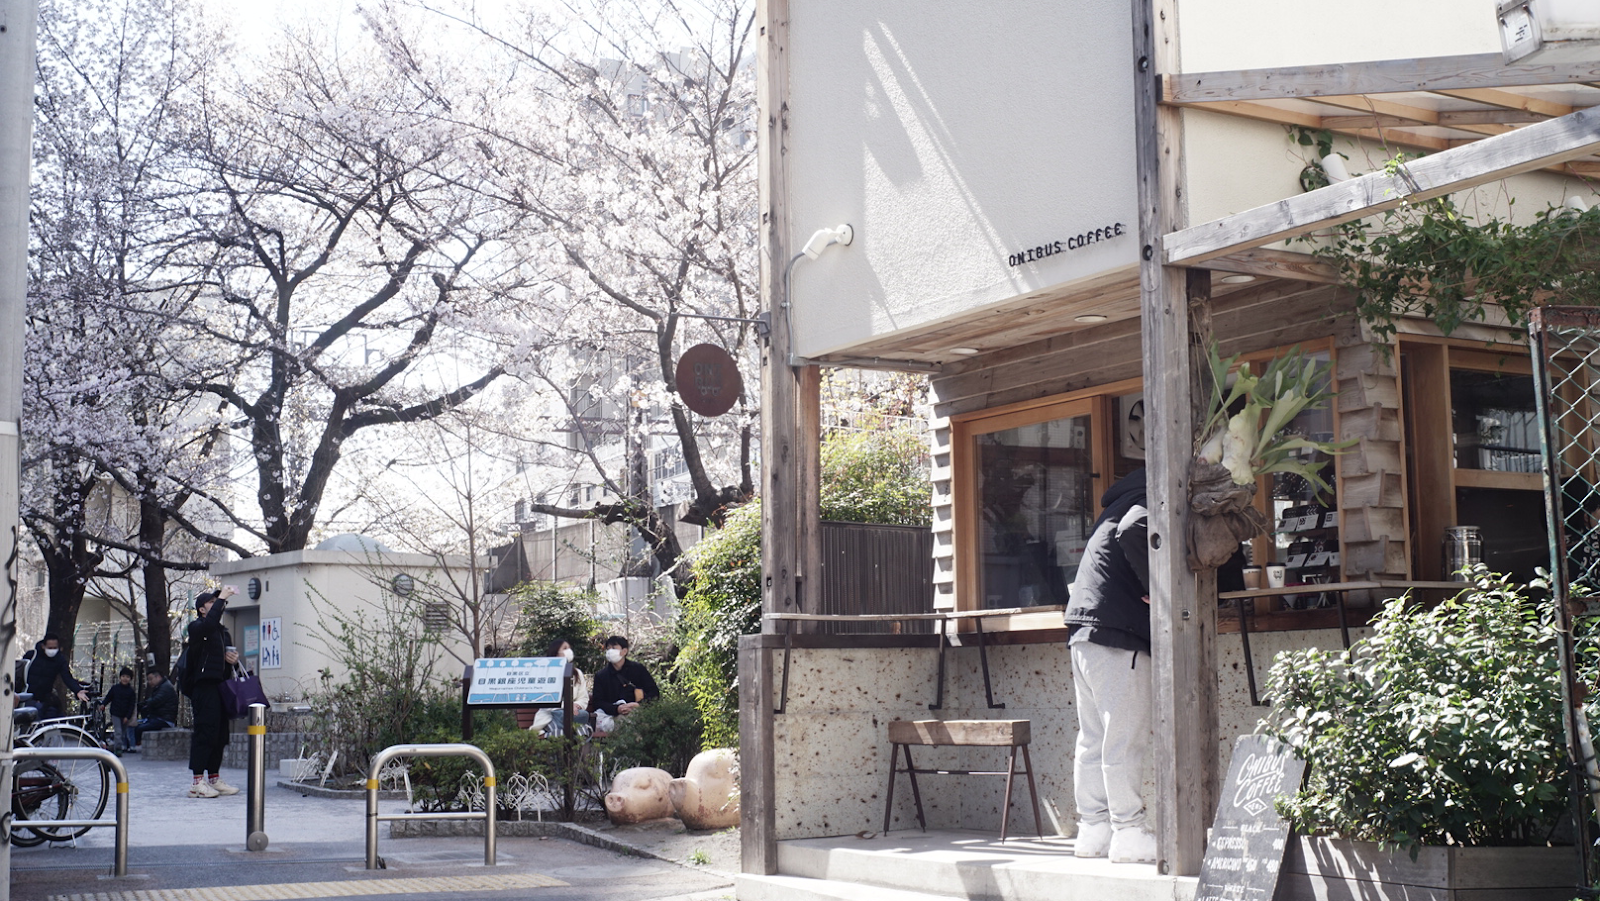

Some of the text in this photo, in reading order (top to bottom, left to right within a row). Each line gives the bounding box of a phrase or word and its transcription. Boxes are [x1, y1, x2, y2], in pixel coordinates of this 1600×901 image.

[1009, 222, 1122, 267] ONIBUS COFFEE
[1236, 750, 1289, 785] ONIBUS
[1233, 773, 1285, 807] COFFEE
